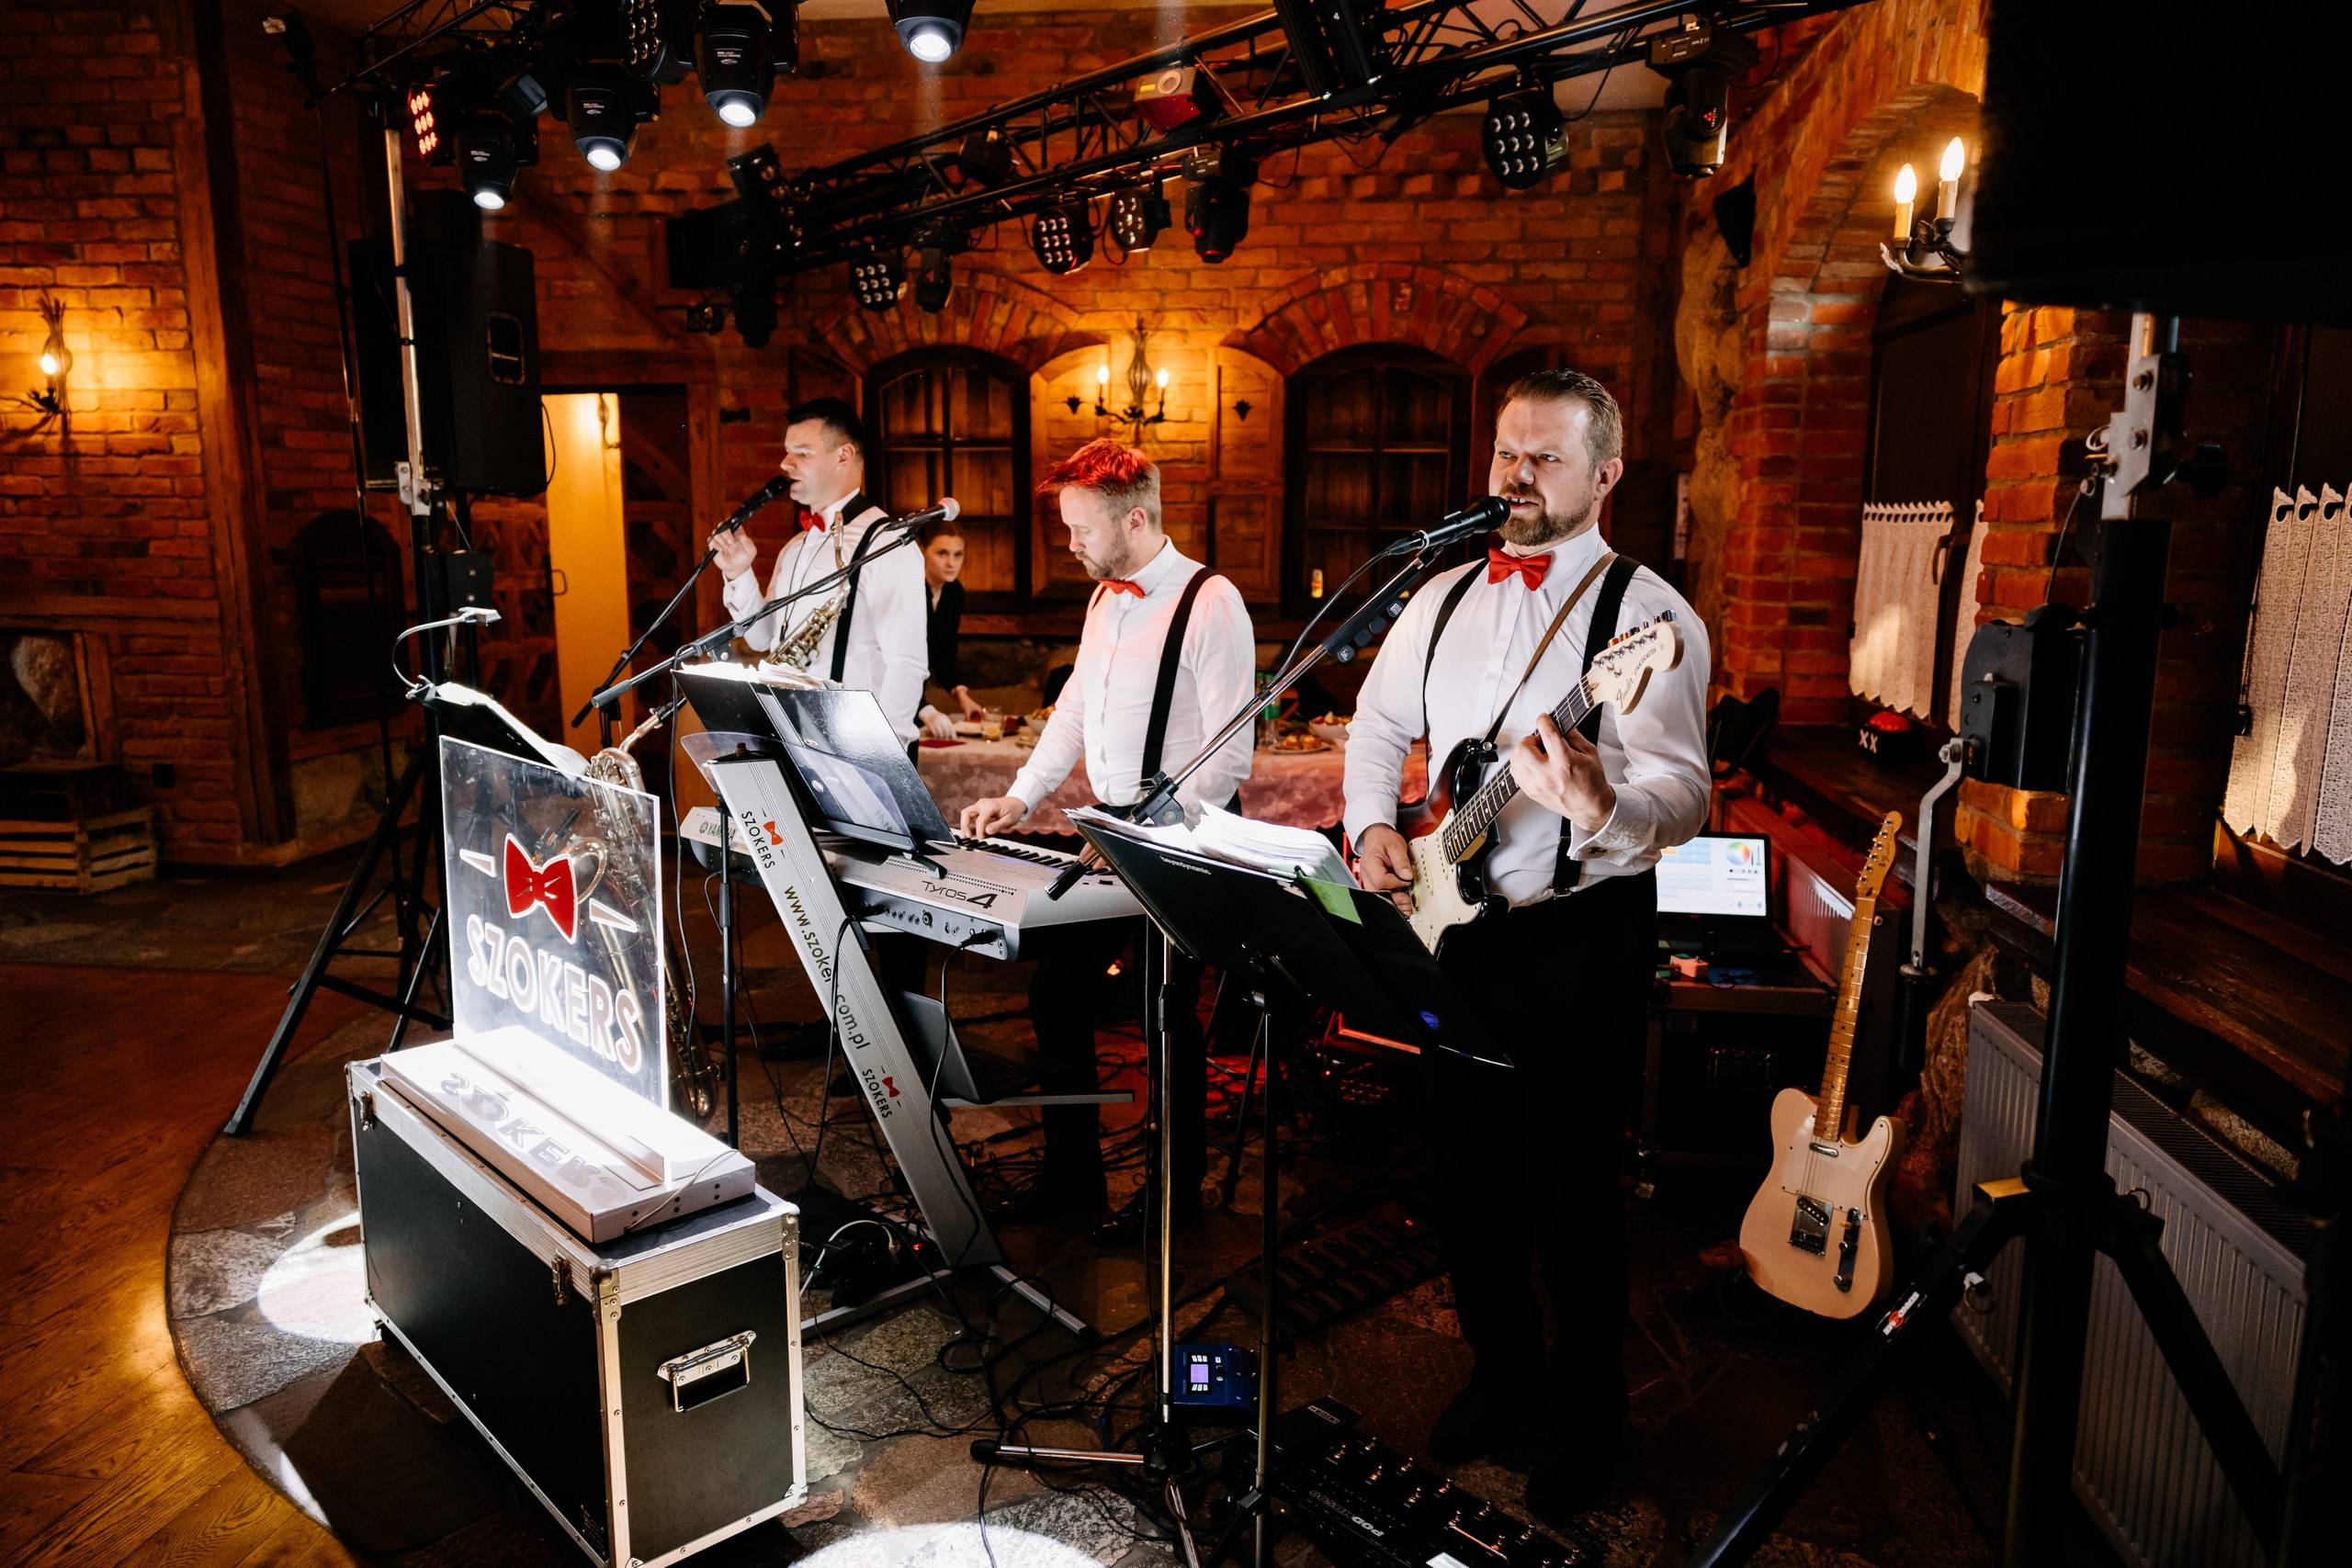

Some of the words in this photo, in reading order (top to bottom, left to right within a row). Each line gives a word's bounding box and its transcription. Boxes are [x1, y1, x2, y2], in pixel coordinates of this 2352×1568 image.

[741, 811, 775, 869] SZOKERS
[467, 914, 642, 1074] SZOKERS
[863, 1068, 893, 1118] SZOKERS
